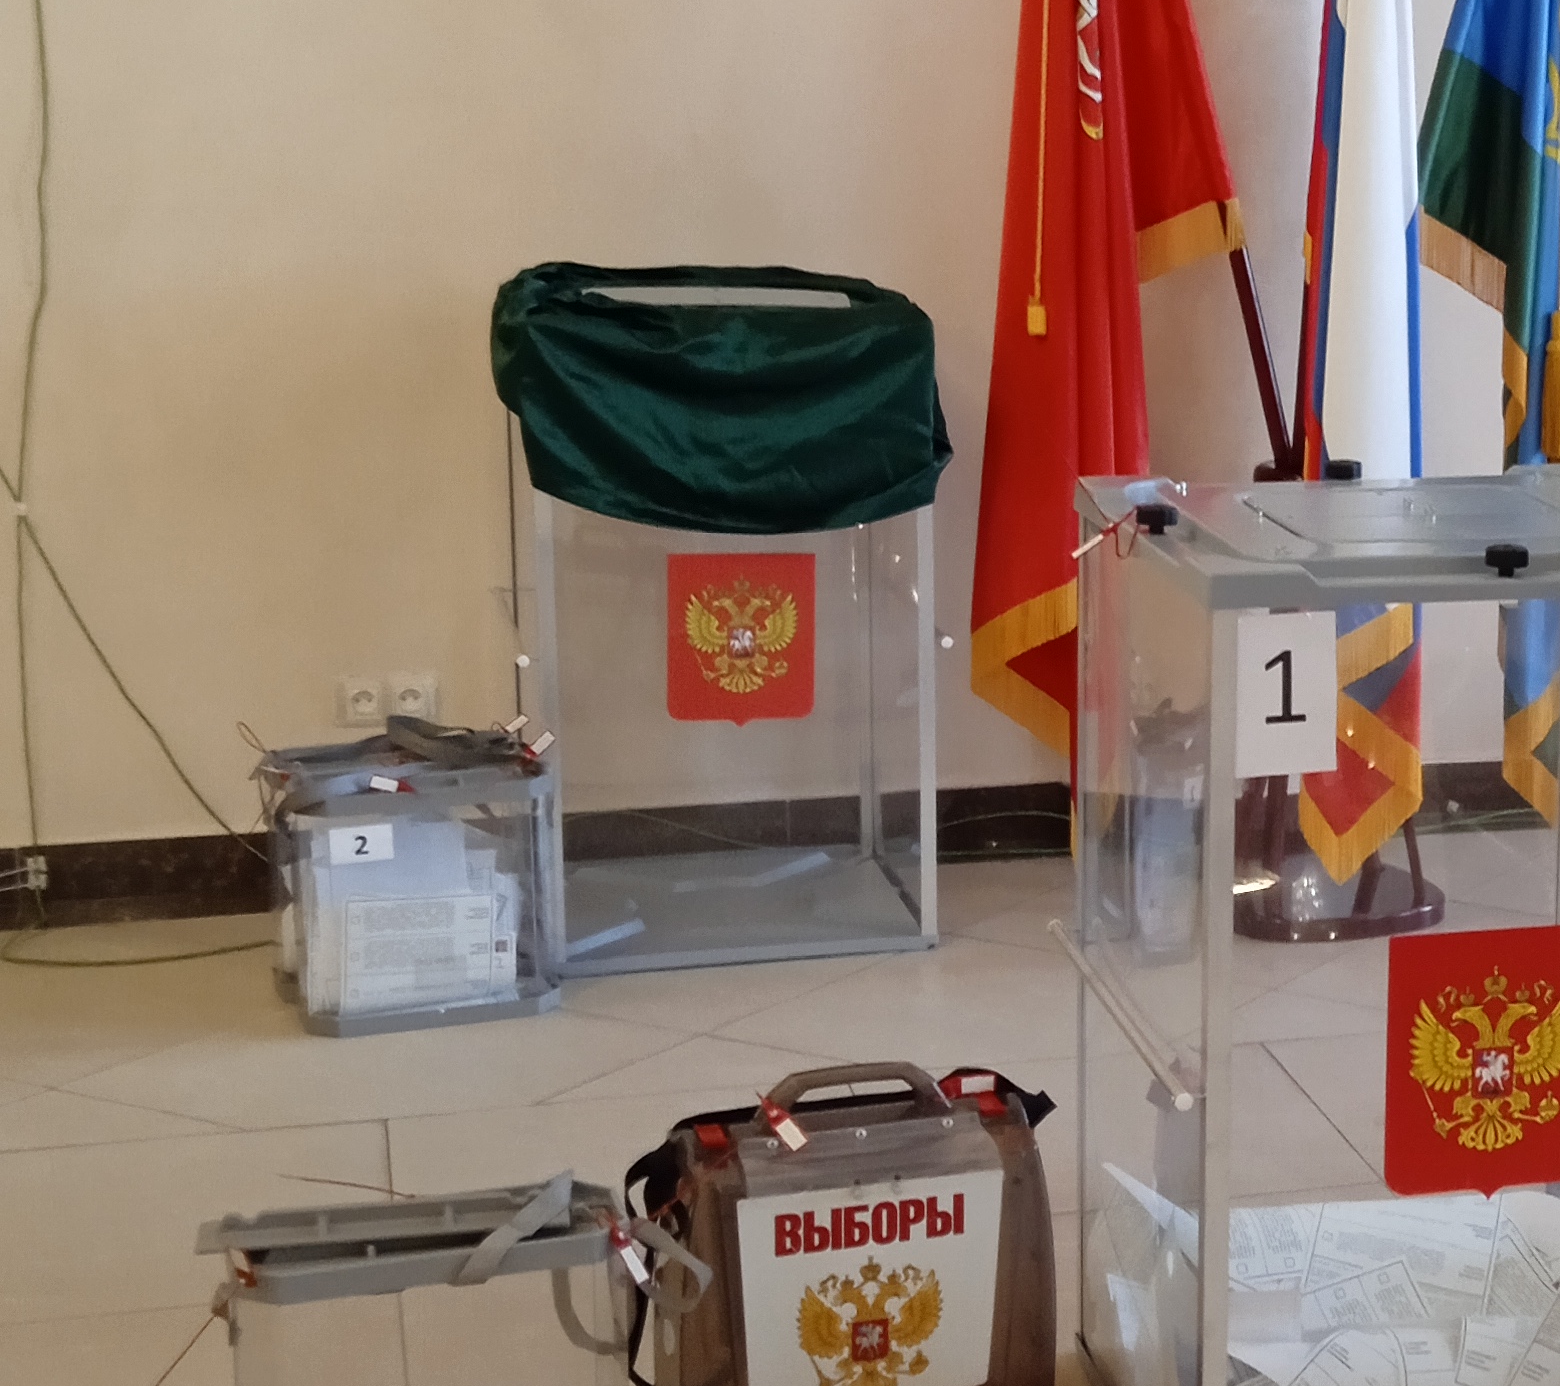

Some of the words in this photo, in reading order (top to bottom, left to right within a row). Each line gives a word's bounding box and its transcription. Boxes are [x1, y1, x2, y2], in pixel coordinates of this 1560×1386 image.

[1264, 650, 1307, 725] 1
[353, 835, 369, 856] 2
[775, 1193, 966, 1258] ВЫБОРЫ
